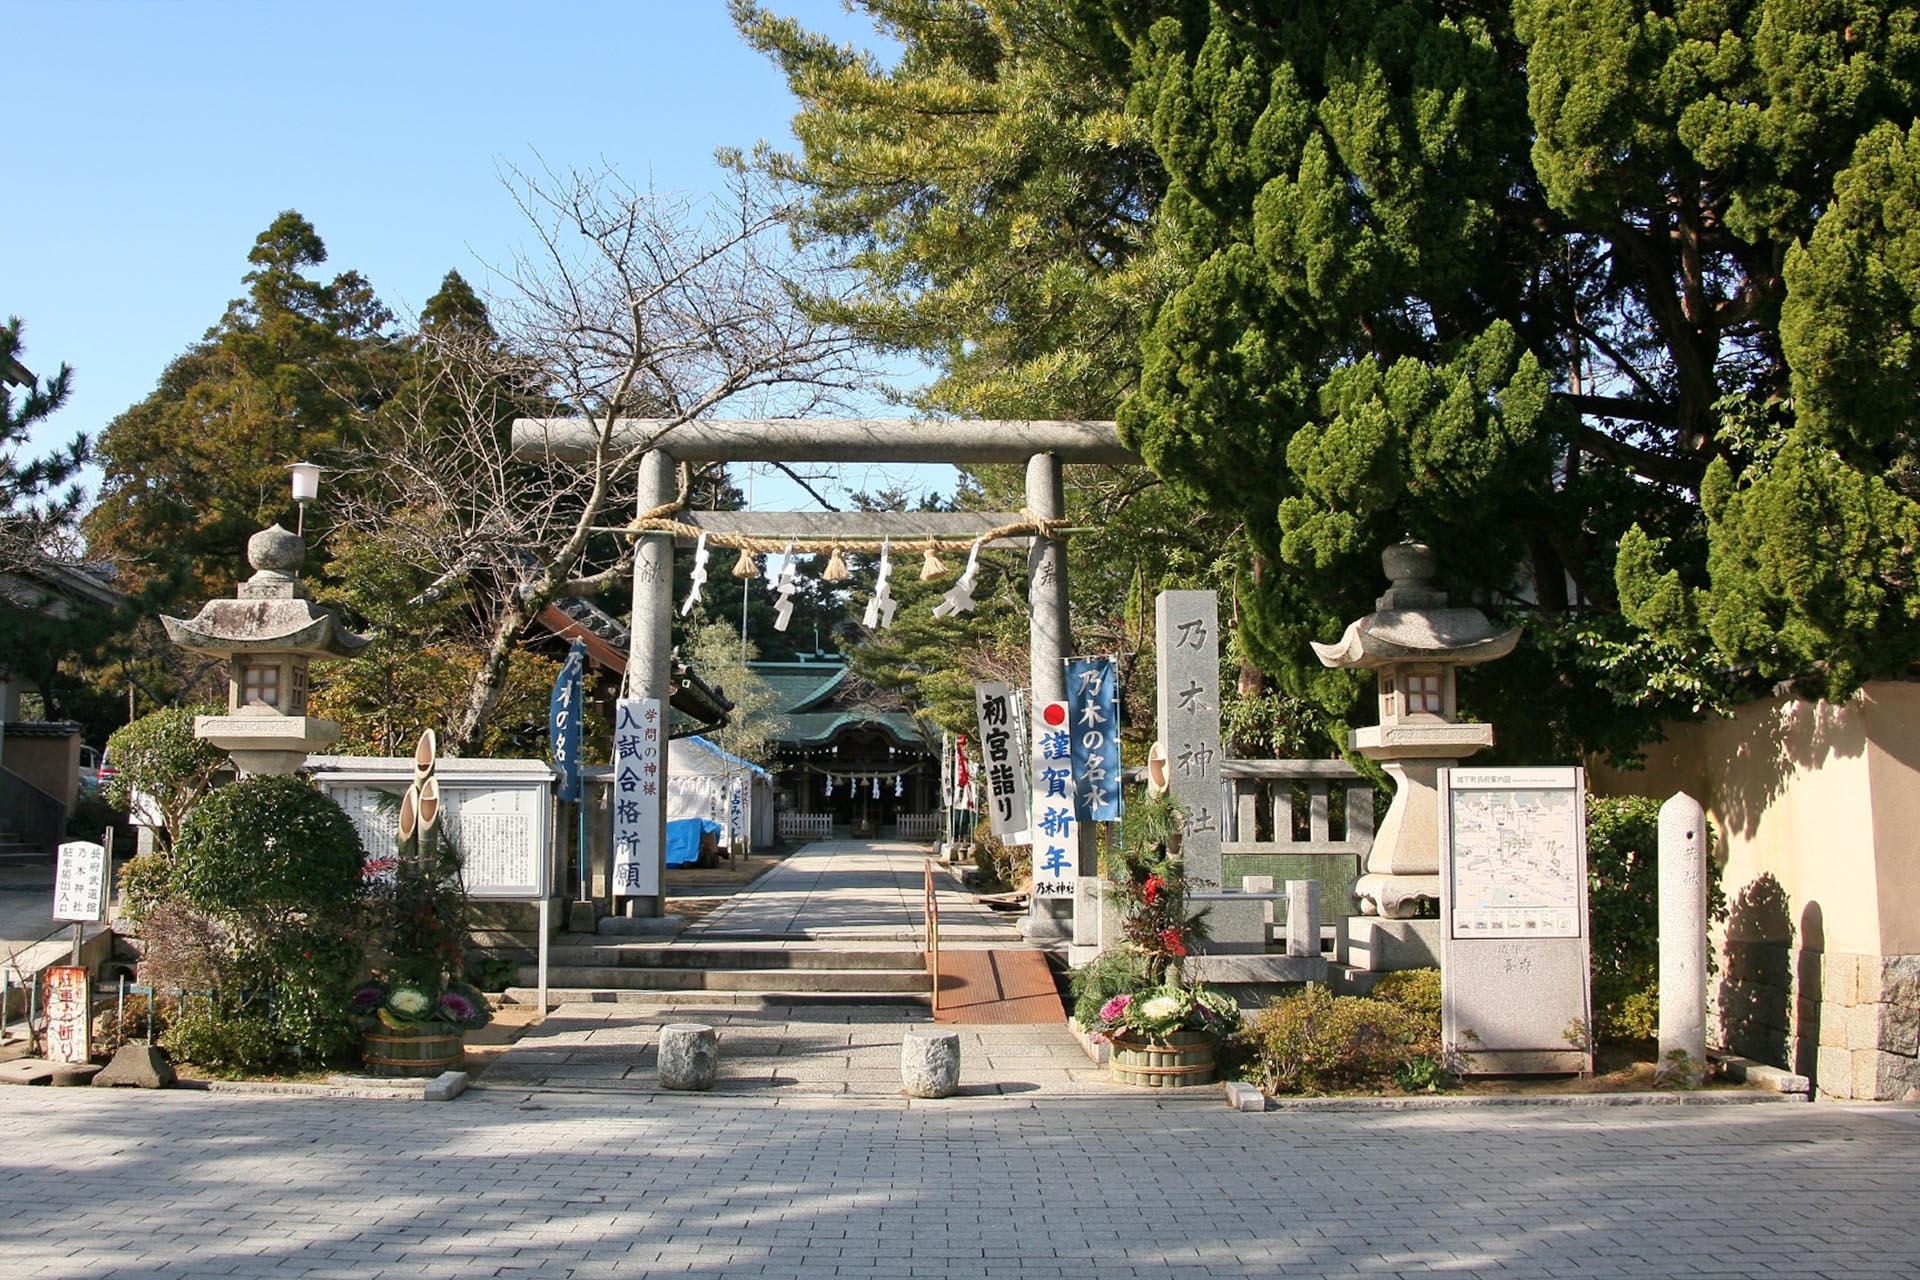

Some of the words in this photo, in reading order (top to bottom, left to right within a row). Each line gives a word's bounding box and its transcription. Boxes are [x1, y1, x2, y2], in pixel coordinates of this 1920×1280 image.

[641, 708, 658, 796] 学問の神様
[982, 694, 1016, 822] 初宮詣り
[1077, 669, 1110, 813] 乃木の名水
[1176, 618, 1217, 839] 乃木神社
[614, 704, 643, 889] 入試合格祈願
[1037, 730, 1073, 878] 謹賀新年
[59, 847, 74, 912] 駐車場出入口
[73, 847, 87, 912] 乃木神社
[86, 847, 101, 913] 長府武道館
